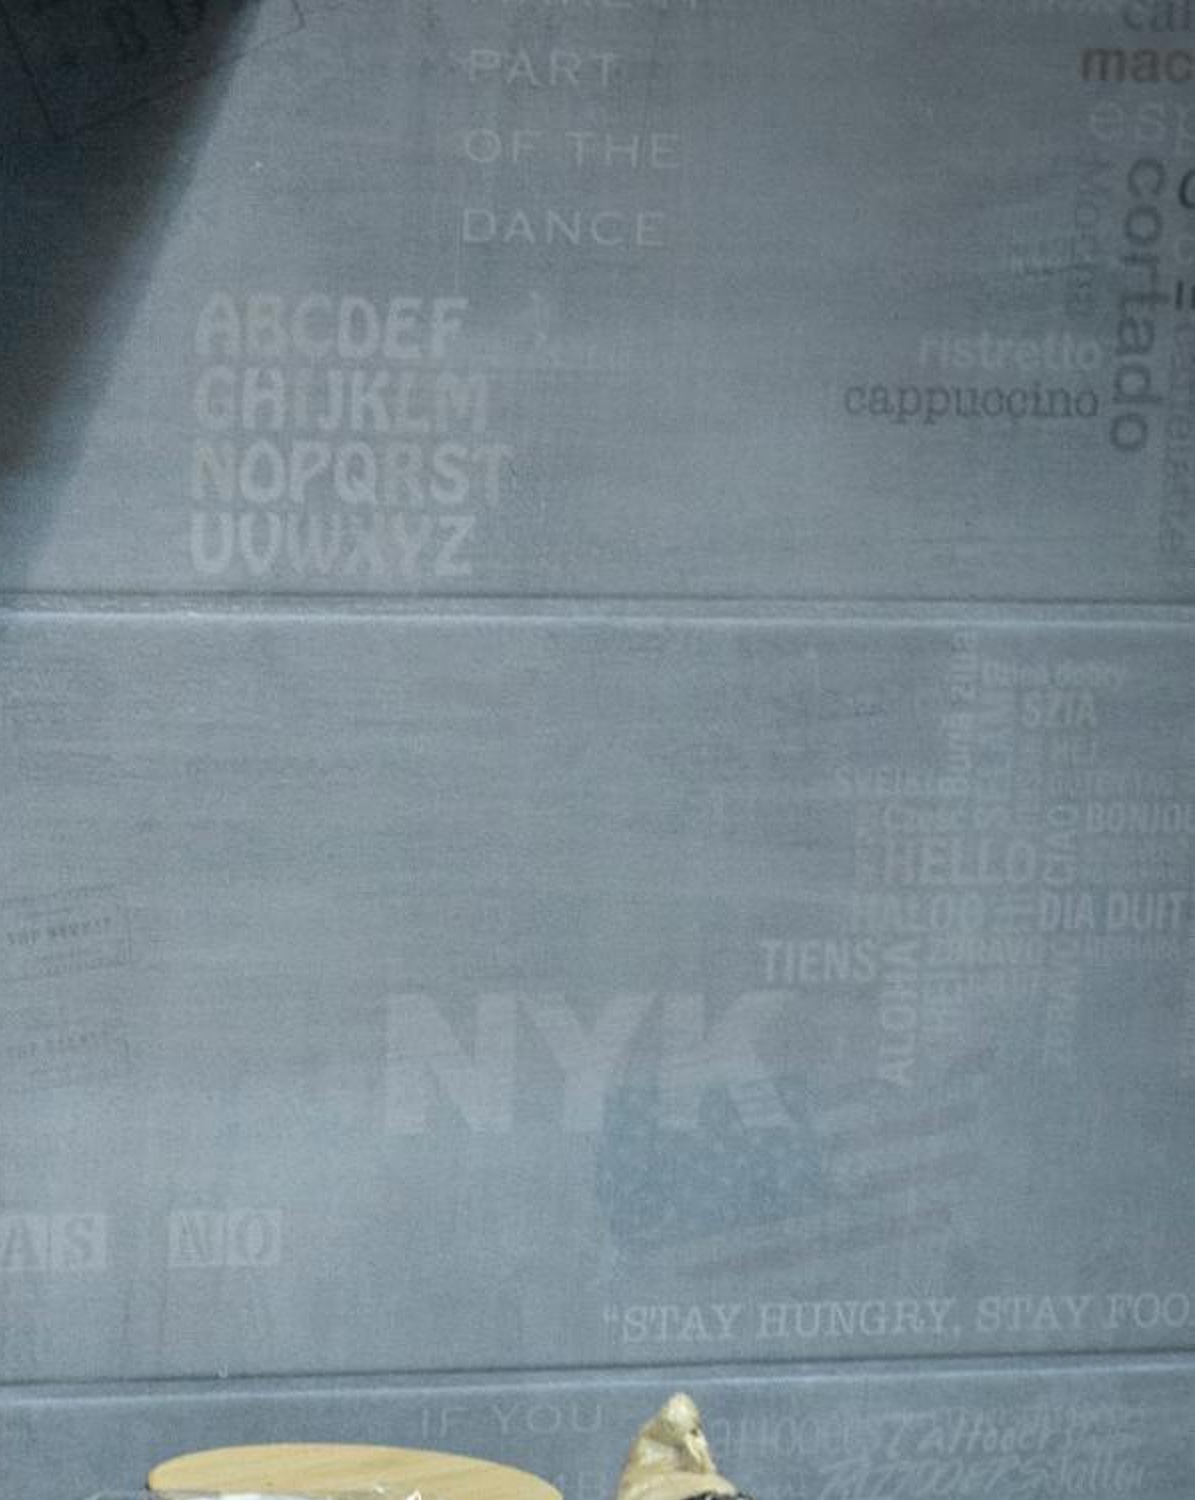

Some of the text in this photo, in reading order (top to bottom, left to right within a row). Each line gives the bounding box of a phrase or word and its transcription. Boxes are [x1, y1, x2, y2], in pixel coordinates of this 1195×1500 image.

[467, 47, 619, 87] PART
[462, 127, 683, 169] OF THE
[461, 206, 666, 248] DANCE
[193, 290, 470, 360] ABCDEF
[1109, 157, 1169, 453] cortado
[917, 330, 1105, 373] ristretto
[192, 364, 490, 433] GHIJKLM
[842, 380, 1101, 426] cappuccino
[189, 438, 516, 507] NOPQRST
[883, 836, 1037, 887] HELLO
[1038, 891, 1095, 932] DIA
[1105, 890, 1188, 931] DUIT
[760, 937, 877, 984] TIENS
[383, 990, 807, 1137] NYK
[754, 1297, 962, 1340] HUNGRY,
[974, 1294, 1092, 1334] STAY
